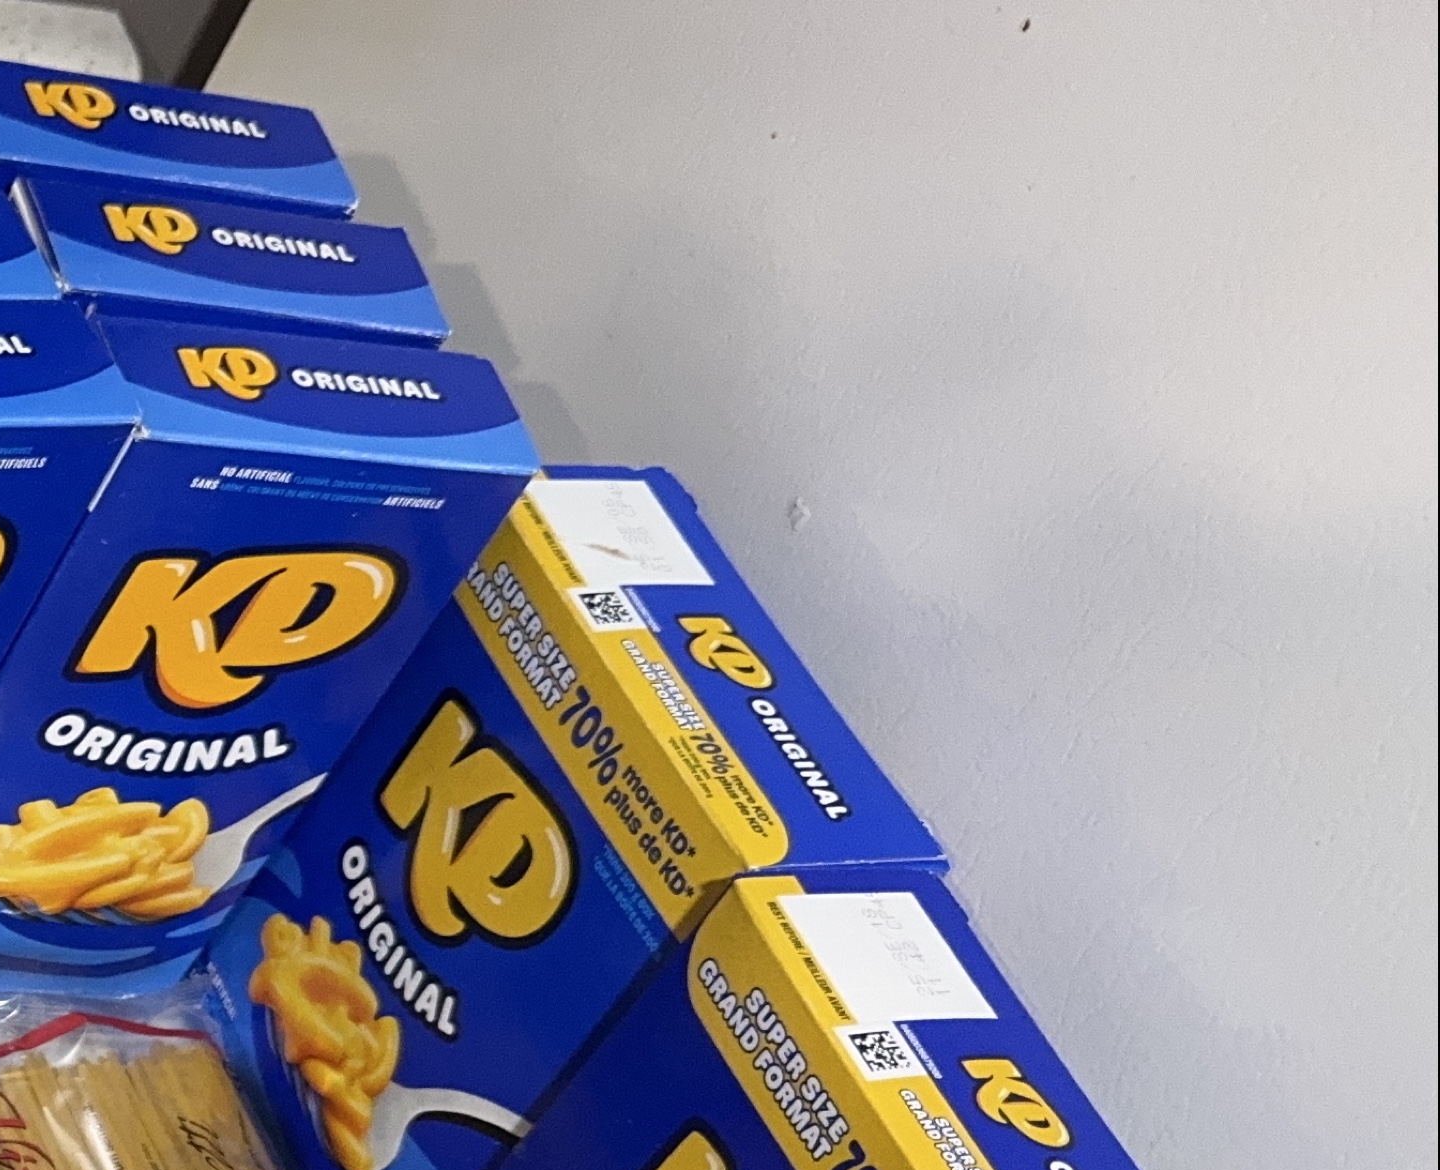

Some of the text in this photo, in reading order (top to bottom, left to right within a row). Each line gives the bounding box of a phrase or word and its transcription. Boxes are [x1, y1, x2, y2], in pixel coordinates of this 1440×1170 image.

[26, 80, 267, 139] KD ORIGINAL
[104, 203, 355, 264] KD ORIGINAL
[179, 346, 441, 401] KD ORIGINAL
[190, 476, 220, 490] SANS
[236, 468, 294, 484] ARTIFICIAL
[75, 552, 397, 708] KD
[493, 562, 543, 642] SUPER
[537, 633, 576, 693] SIZE
[499, 617, 563, 710] FORMAT
[678, 617, 772, 688] KD
[45, 713, 289, 773] ORIGINAL
[558, 685, 623, 786] 70%
[751, 699, 847, 820] ORIGINAL
[380, 697, 573, 938] KD
[603, 786, 642, 835] plus
[638, 833, 662, 864] de
[622, 765, 664, 824] more
[340, 844, 458, 1036] ORIGINAL
[827, 994, 851, 1021] AVANT
[697, 958, 832, 1161] GRAND FORMAT
[745, 987, 850, 1144] SUPER SIZE
[898, 1089, 942, 1149] GRAND
[962, 1060, 1071, 1148] KD
[934, 1115, 975, 1169] SUPER
